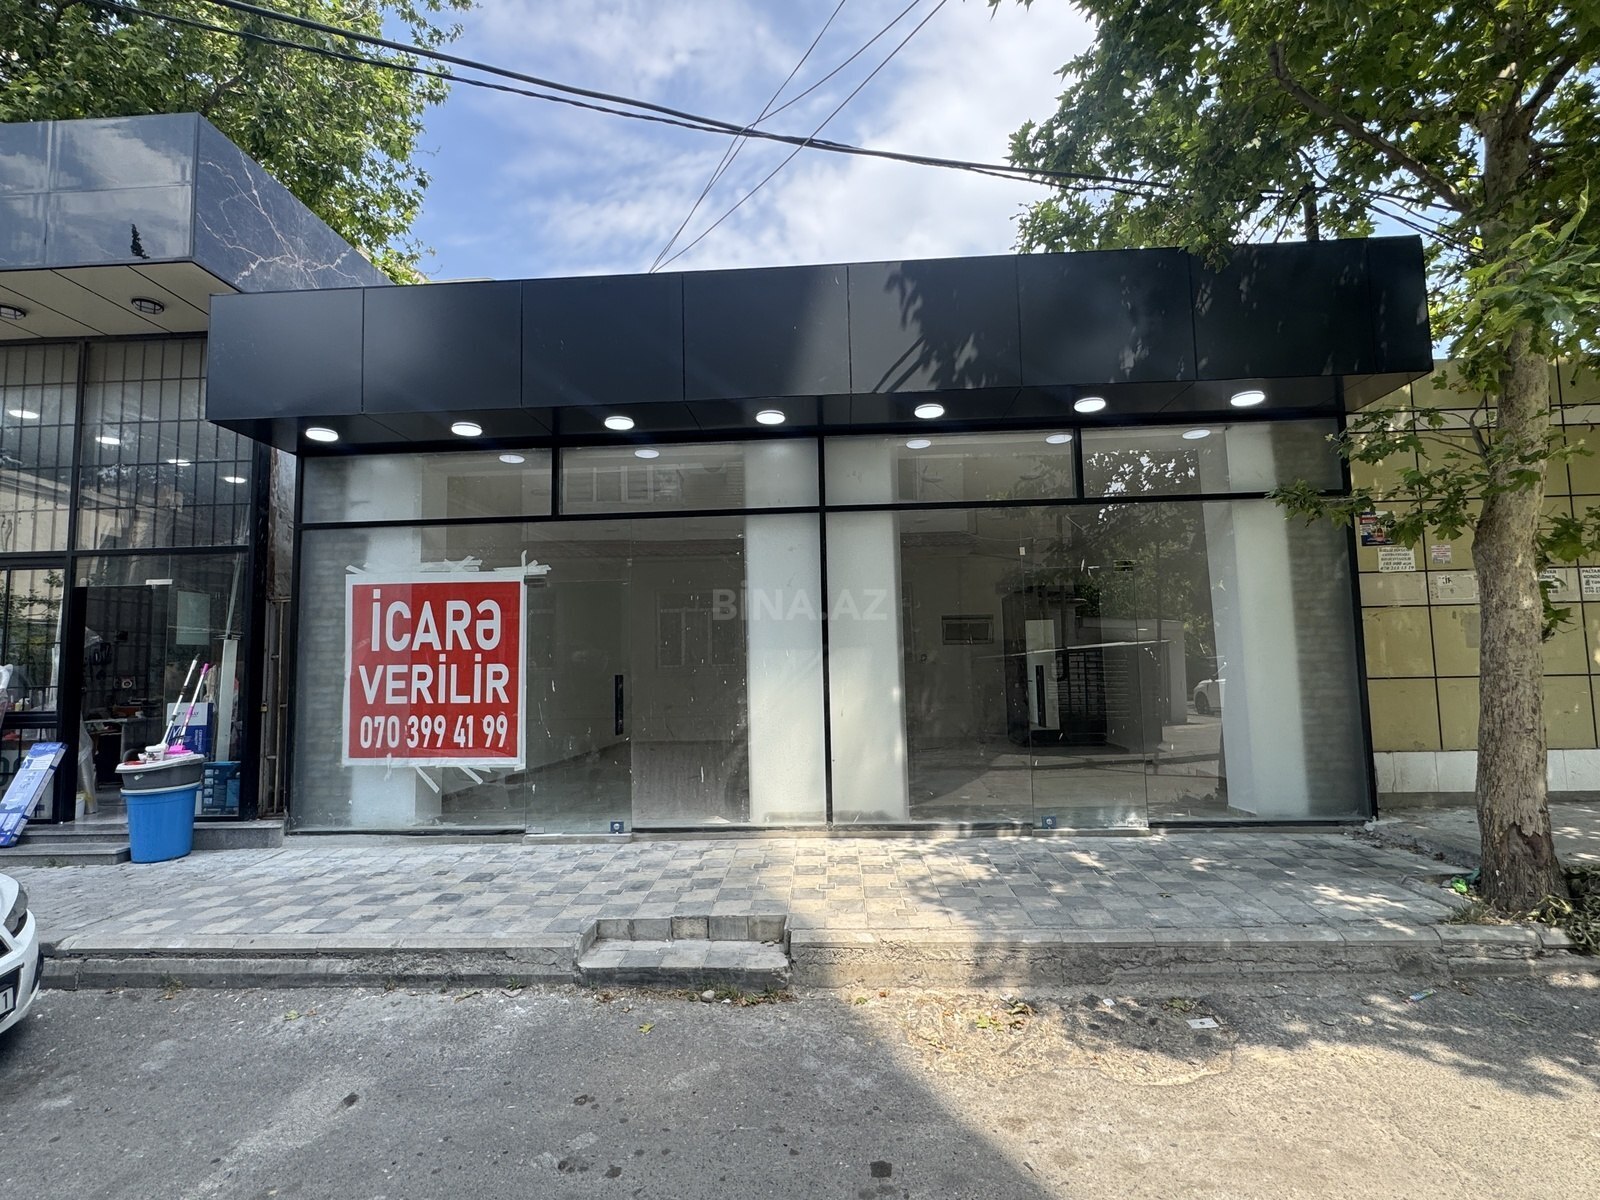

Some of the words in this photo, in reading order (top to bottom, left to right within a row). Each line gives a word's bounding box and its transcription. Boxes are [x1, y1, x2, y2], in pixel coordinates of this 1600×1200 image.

[371, 589, 502, 651] İCARƏ
[358, 653, 510, 705] VERİLİR
[360, 715, 400, 749] 070
[406, 715, 447, 748] 399
[453, 715, 474, 748] 41
[483, 714, 508, 748] 99
